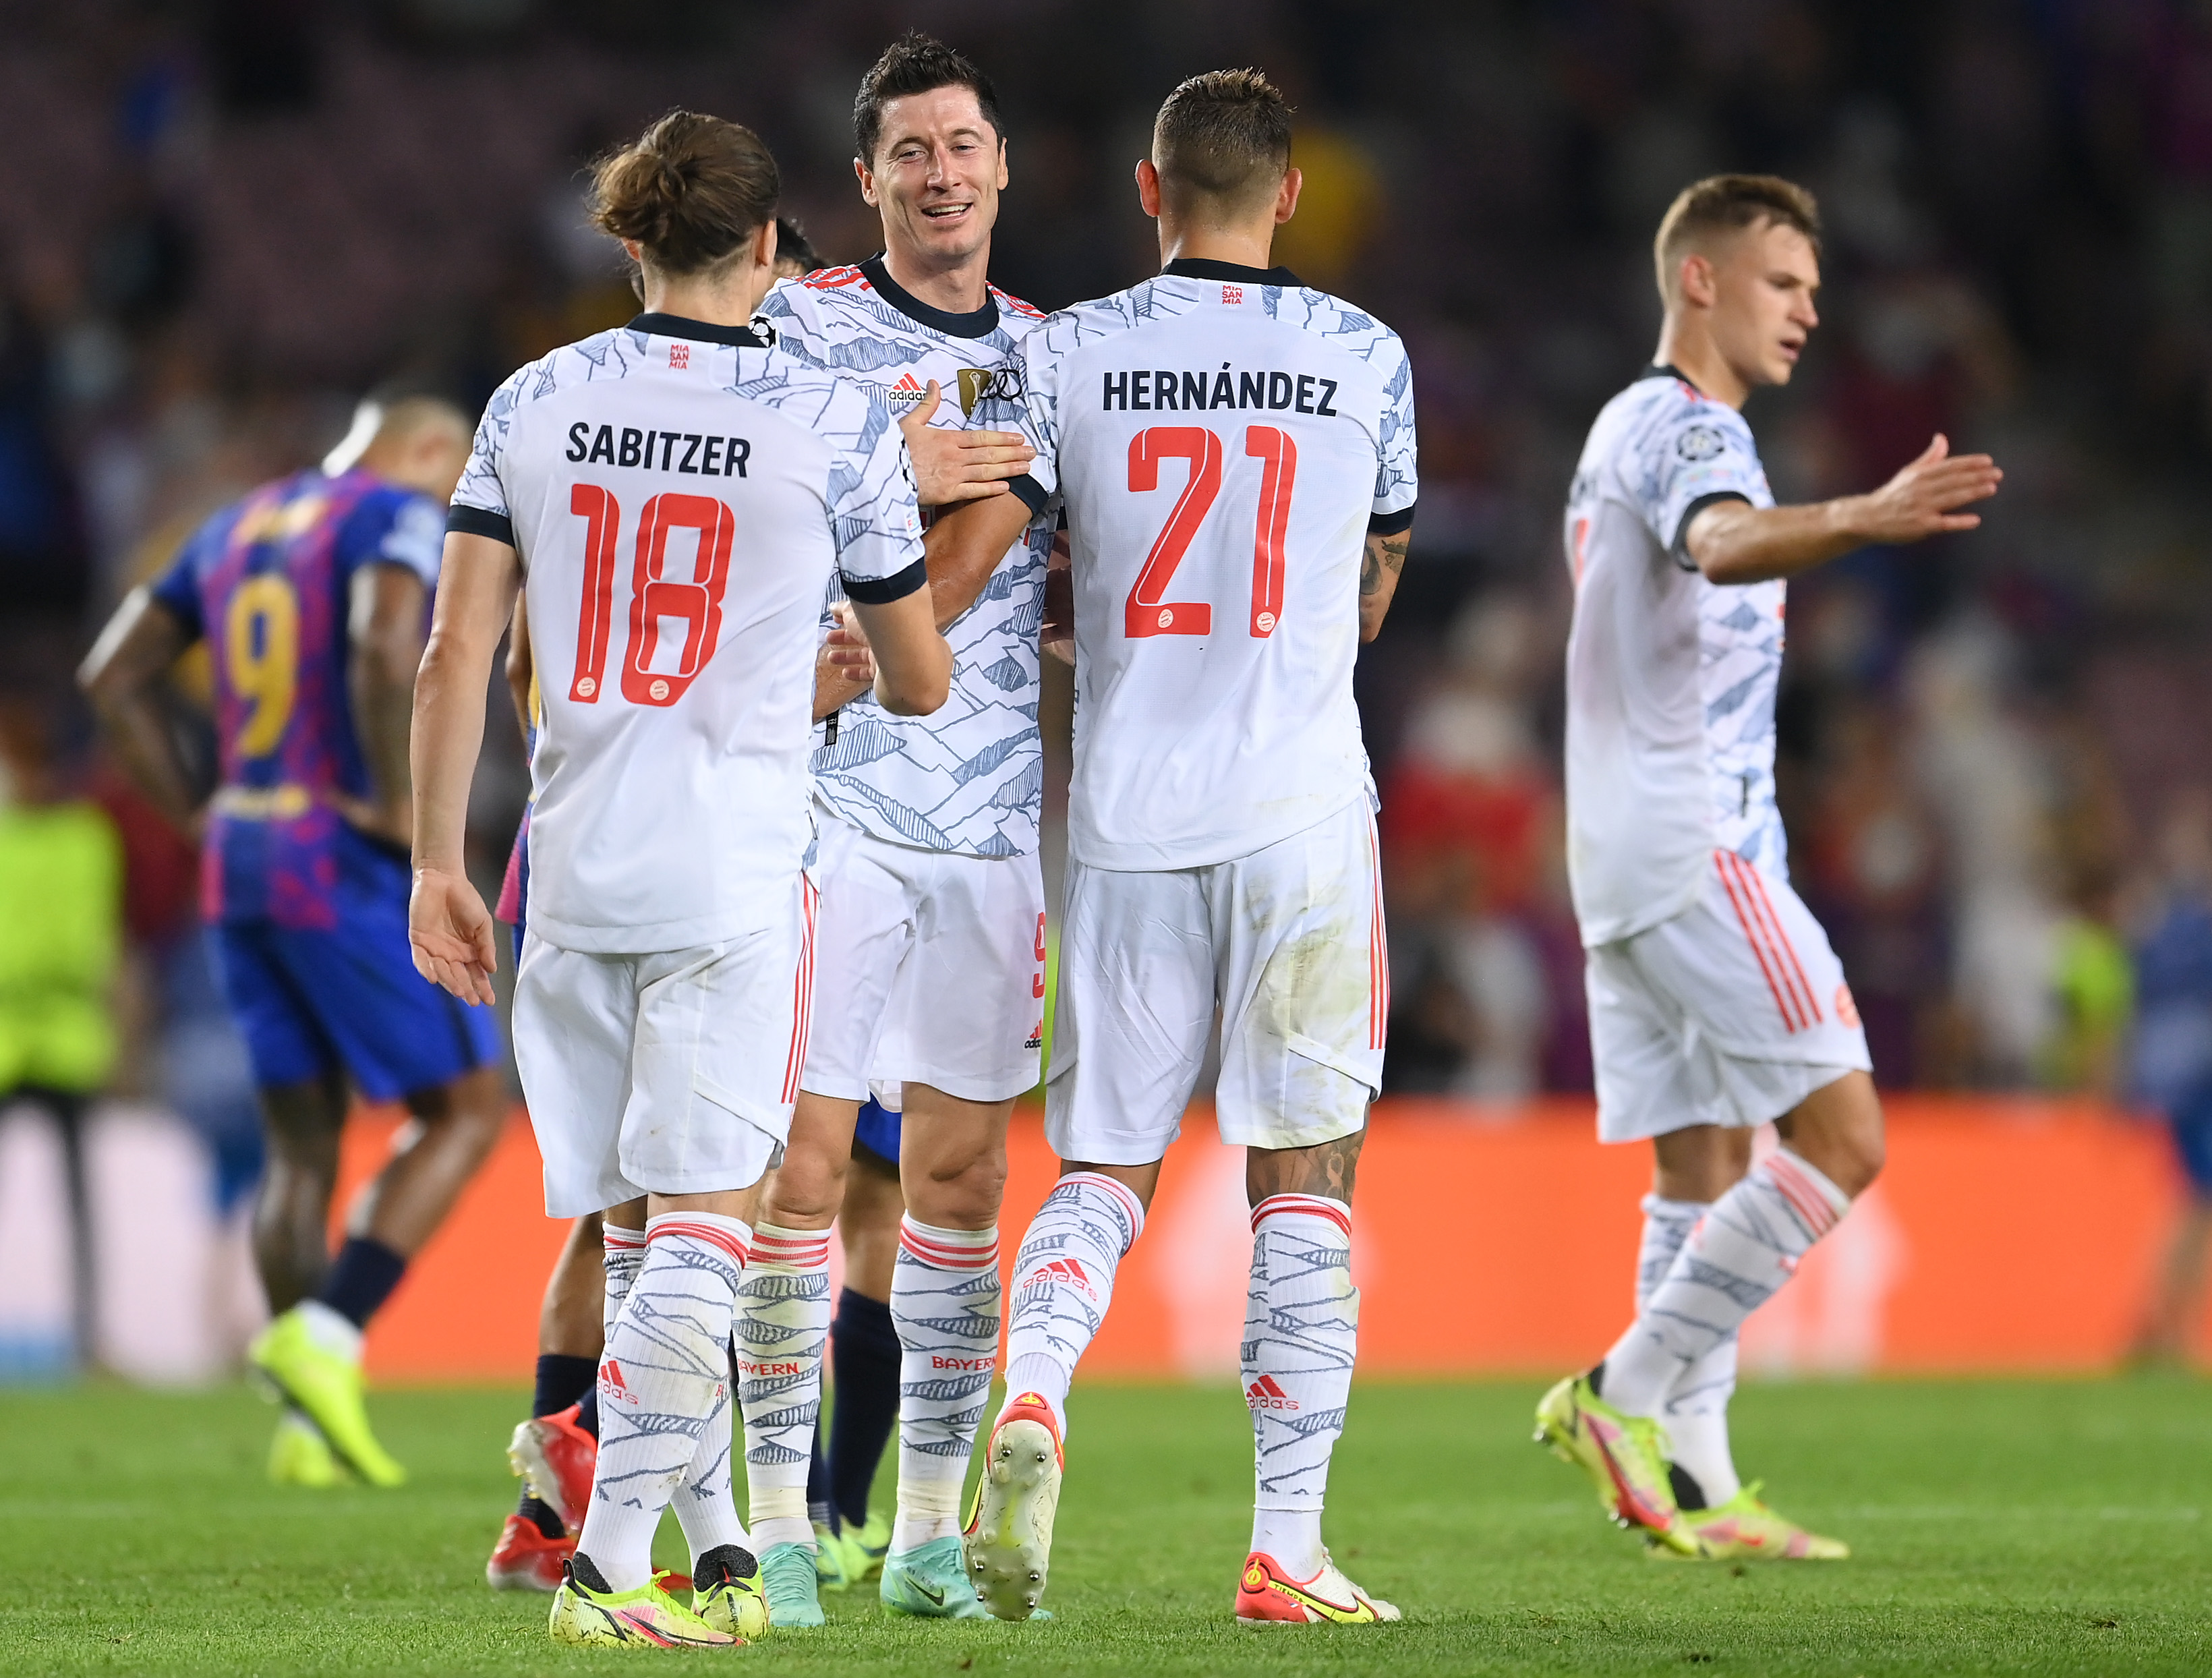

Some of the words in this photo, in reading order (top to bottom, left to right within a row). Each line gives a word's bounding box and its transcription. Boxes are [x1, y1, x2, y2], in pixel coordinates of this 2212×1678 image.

[668, 361, 687, 370] MIA
[670, 352, 689, 361] SAN
[889, 390, 926, 401] adida
[1103, 361, 1337, 417] HERNÁNDEZ
[566, 422, 751, 478] SABITZER
[1125, 425, 1298, 639] 21
[569, 483, 736, 707] 18
[226, 573, 299, 758] 9
[1023, 1271, 1097, 1302] adidas
[738, 1358, 799, 1375] AYERN
[1246, 1396, 1300, 1410] didas
